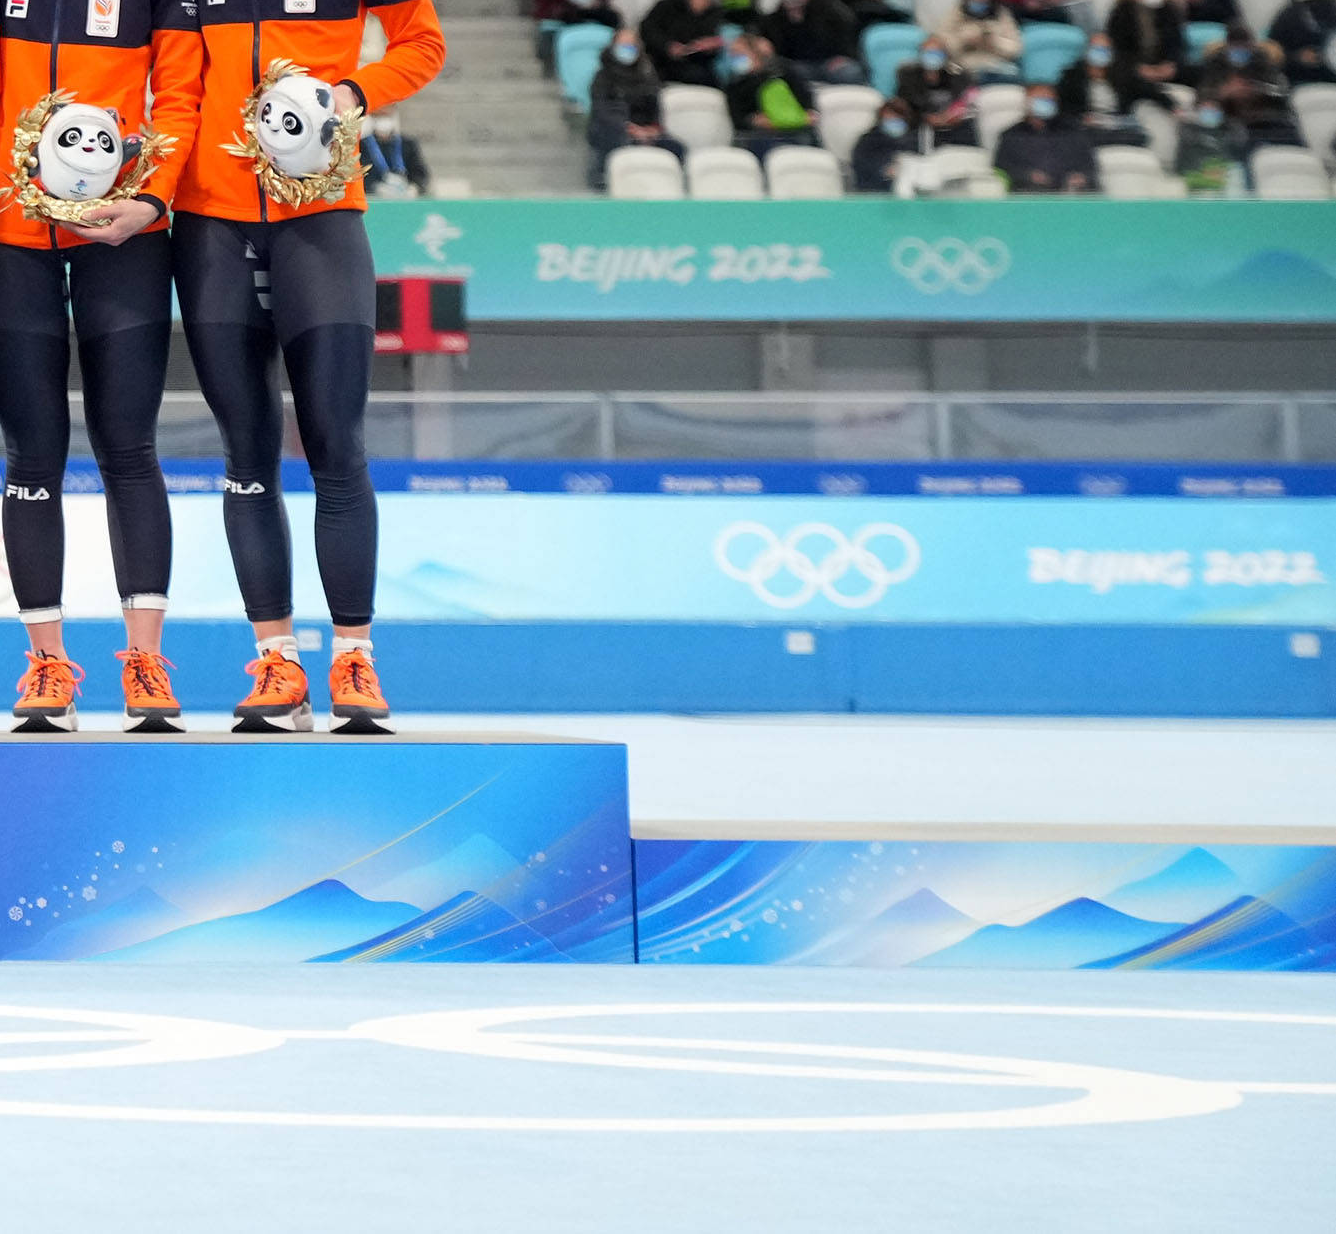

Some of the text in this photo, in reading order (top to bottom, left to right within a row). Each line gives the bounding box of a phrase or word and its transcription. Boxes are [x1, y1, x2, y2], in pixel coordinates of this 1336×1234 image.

[537, 243, 832, 293] BEIJING 2022
[6, 484, 50, 500] FILA
[225, 479, 265, 494] FILA
